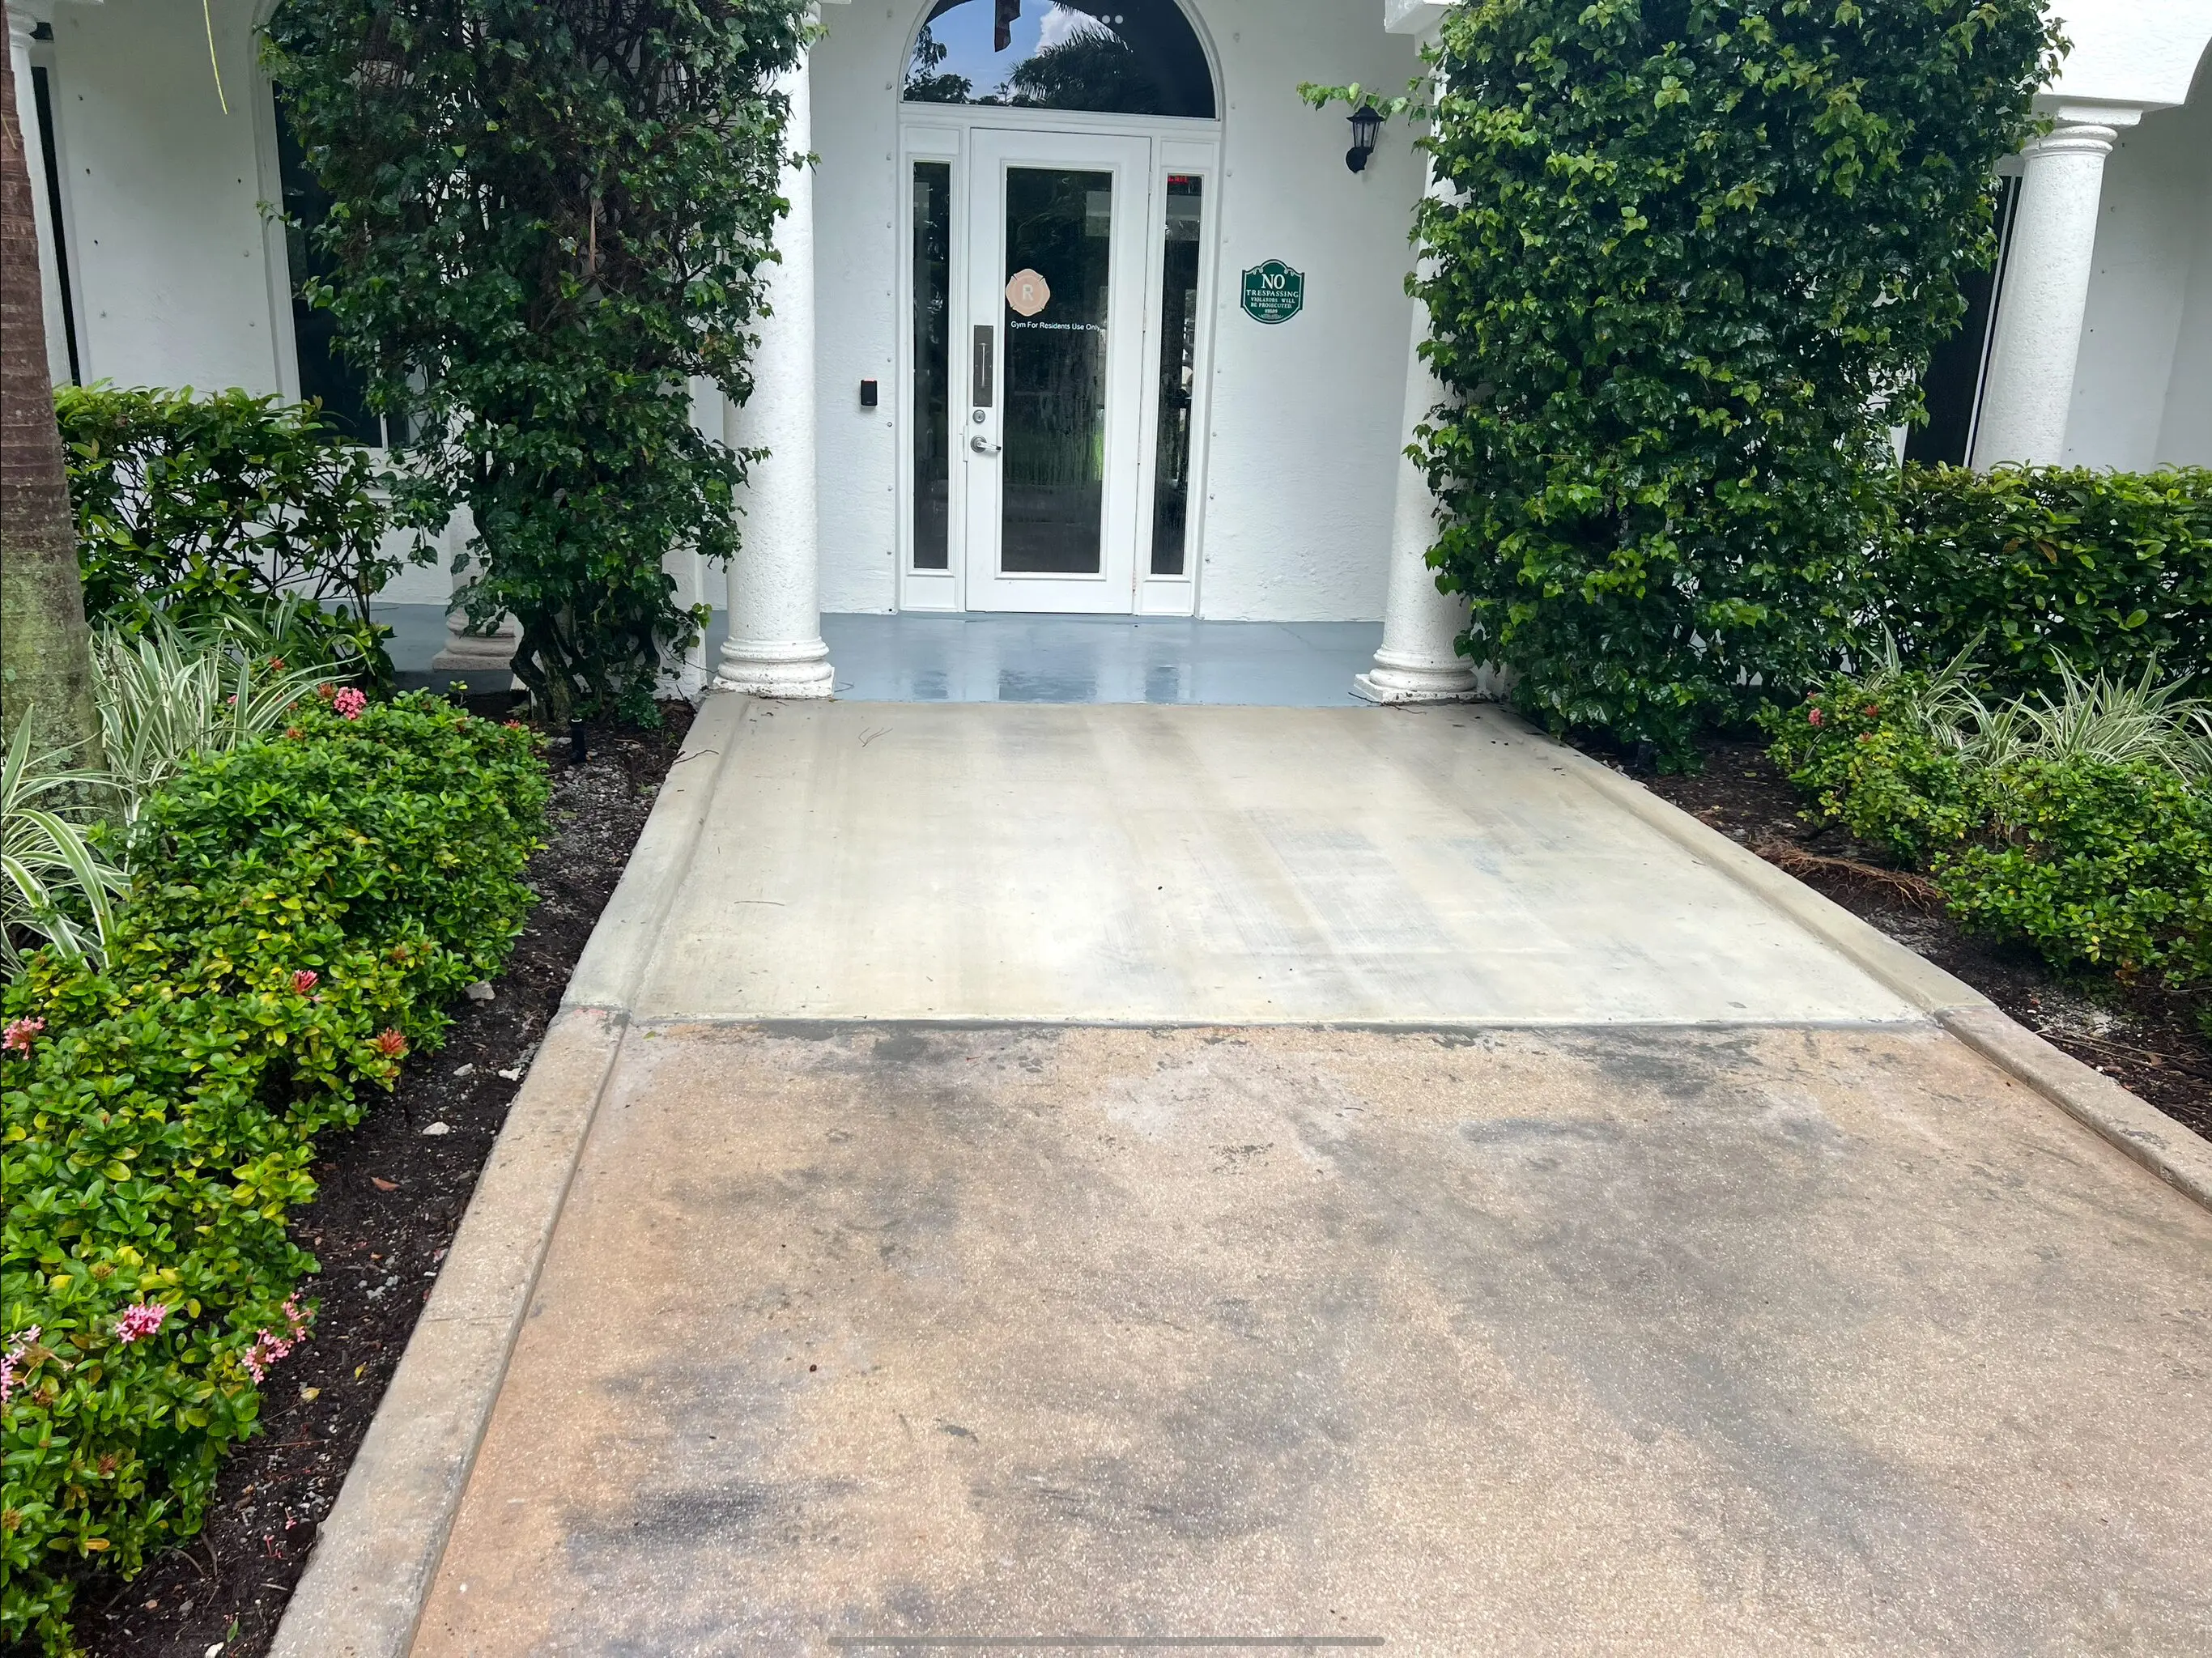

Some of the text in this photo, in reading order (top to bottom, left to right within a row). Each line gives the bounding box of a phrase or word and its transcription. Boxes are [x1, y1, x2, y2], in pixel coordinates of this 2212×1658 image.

[1261, 274, 1286, 290] NO
[1022, 284, 1034, 301] R
[1246, 289, 1299, 298] TRESPASSING
[1010, 321, 1026, 329] Gym
[1039, 321, 1070, 329] Residents
[1086, 323, 1100, 332] Only
